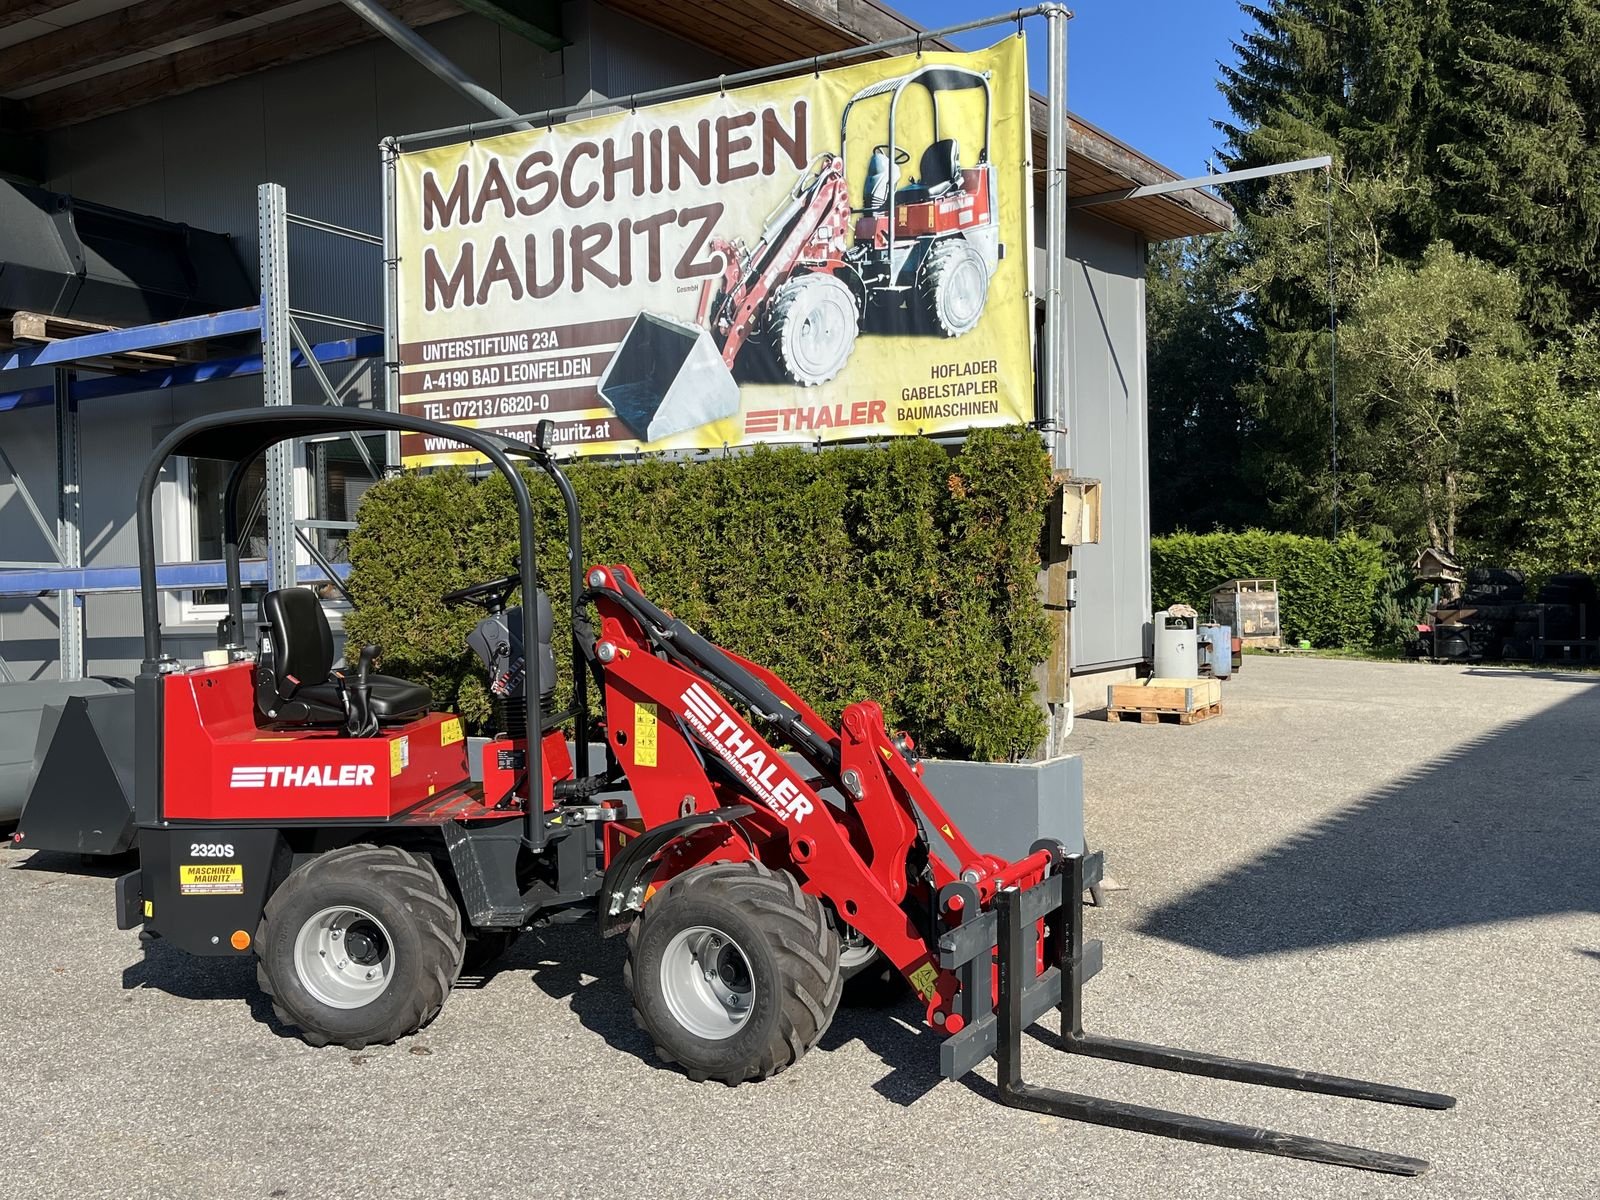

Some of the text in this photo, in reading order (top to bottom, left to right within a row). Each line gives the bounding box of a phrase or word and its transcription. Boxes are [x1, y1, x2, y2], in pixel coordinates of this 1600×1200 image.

[423, 100, 808, 231] MASCHINEN
[424, 202, 725, 312] MAURITZ
[423, 331, 559, 361] UNTERSTIFTUNG 23A
[423, 357, 591, 391] A-4190 BAD LEONFELDEN
[931, 360, 998, 380] HOFLADER
[901, 380, 998, 402] GABELSTAPLER
[424, 394, 549, 420] TEL: 07213/6820-0
[780, 400, 887, 431] THALER
[897, 400, 998, 421] BAUMASCHINEN
[266, 764, 376, 788] THALER
[683, 708, 791, 822] www.maschinen-mauritz.at
[712, 712, 814, 824] THALER
[190, 843, 235, 858] 2320S
[187, 867, 236, 875] MASCHINEN
